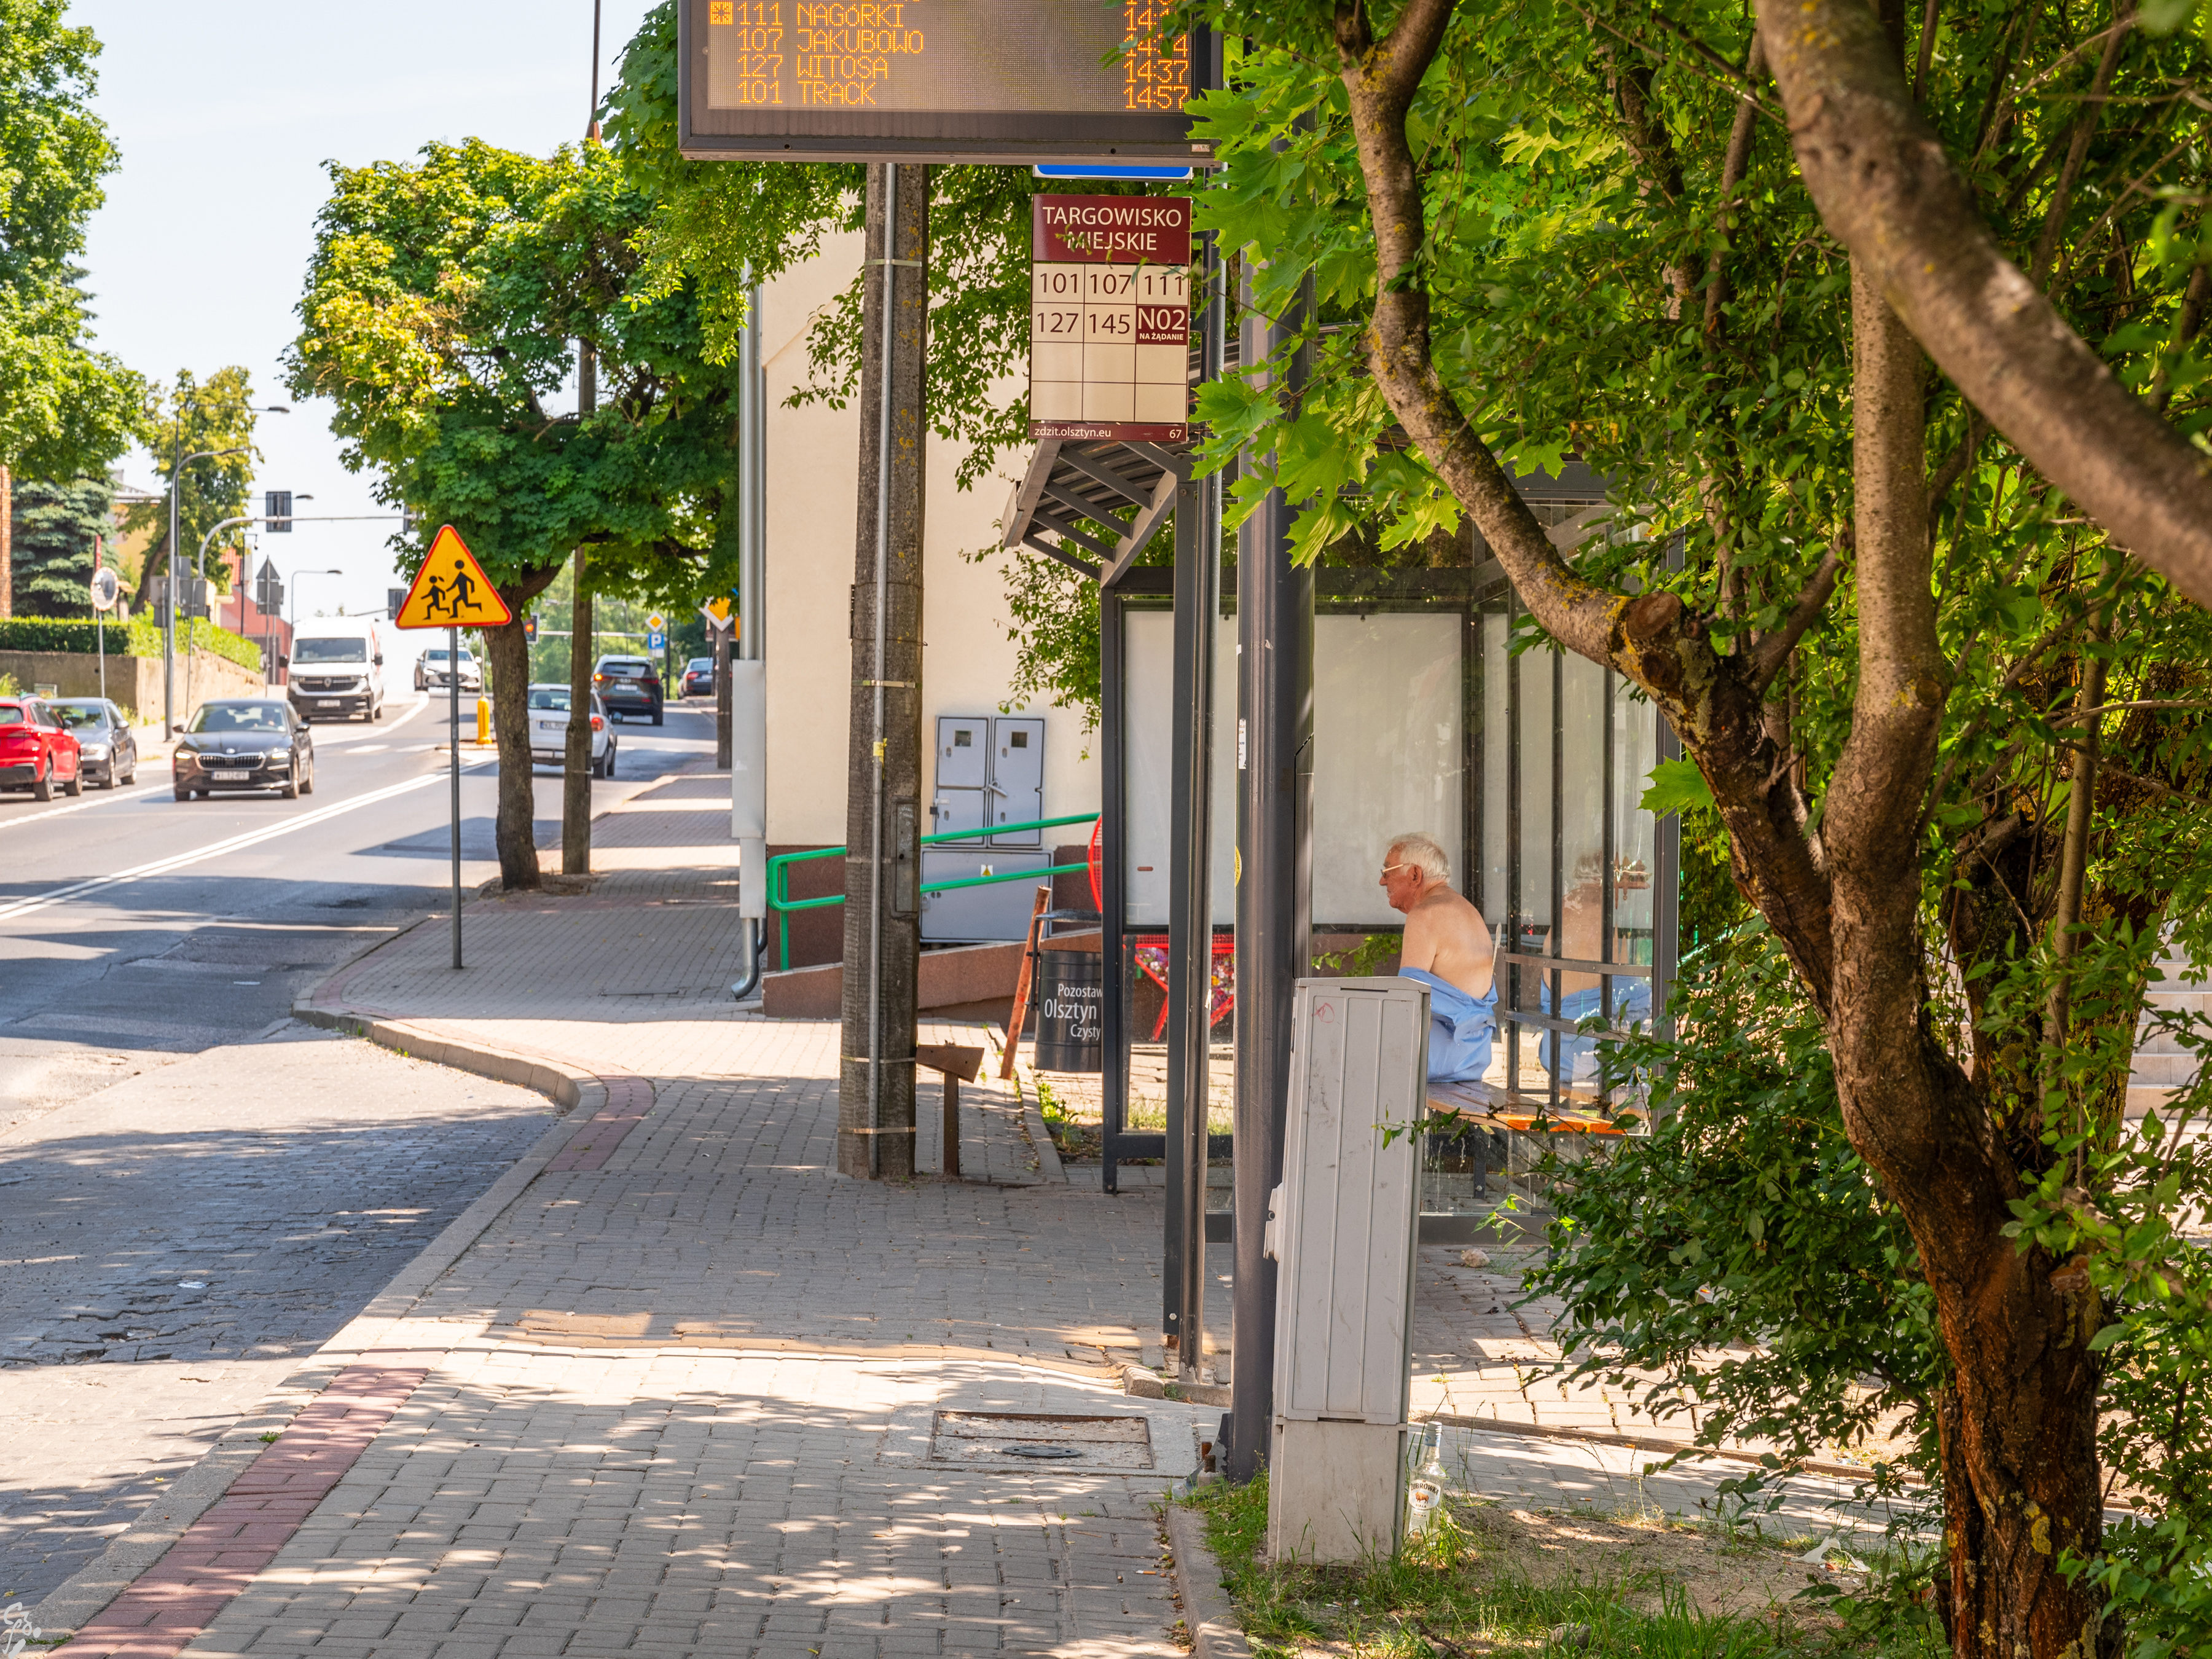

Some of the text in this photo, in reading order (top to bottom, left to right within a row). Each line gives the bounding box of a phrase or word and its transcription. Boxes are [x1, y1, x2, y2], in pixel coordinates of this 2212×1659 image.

[737, 2, 1177, 31] 111 NAGÓRKI 14:
[737, 28, 1188, 57] 107 JAKUBOWO 14:4
[737, 54, 1188, 83] 127 WITOSA 14:37
[737, 80, 1188, 109] 101 TRACK 14:57
[1042, 206, 1182, 227] TARGOWISKO
[1067, 231, 1158, 251] MIEJSKIE
[1040, 272, 1183, 296] 101 107 111
[1037, 308, 1186, 334] 127 145 N02
[1151, 331, 1184, 342] ŻĄDANIE
[1034, 426, 1182, 439] zdzit.olsztyn.eu 67
[651, 634, 662, 648] P
[1057, 983, 1102, 998] Pozostaw
[1045, 998, 1097, 1024] Olsztyn
[1070, 1024, 1101, 1041] Czysty
